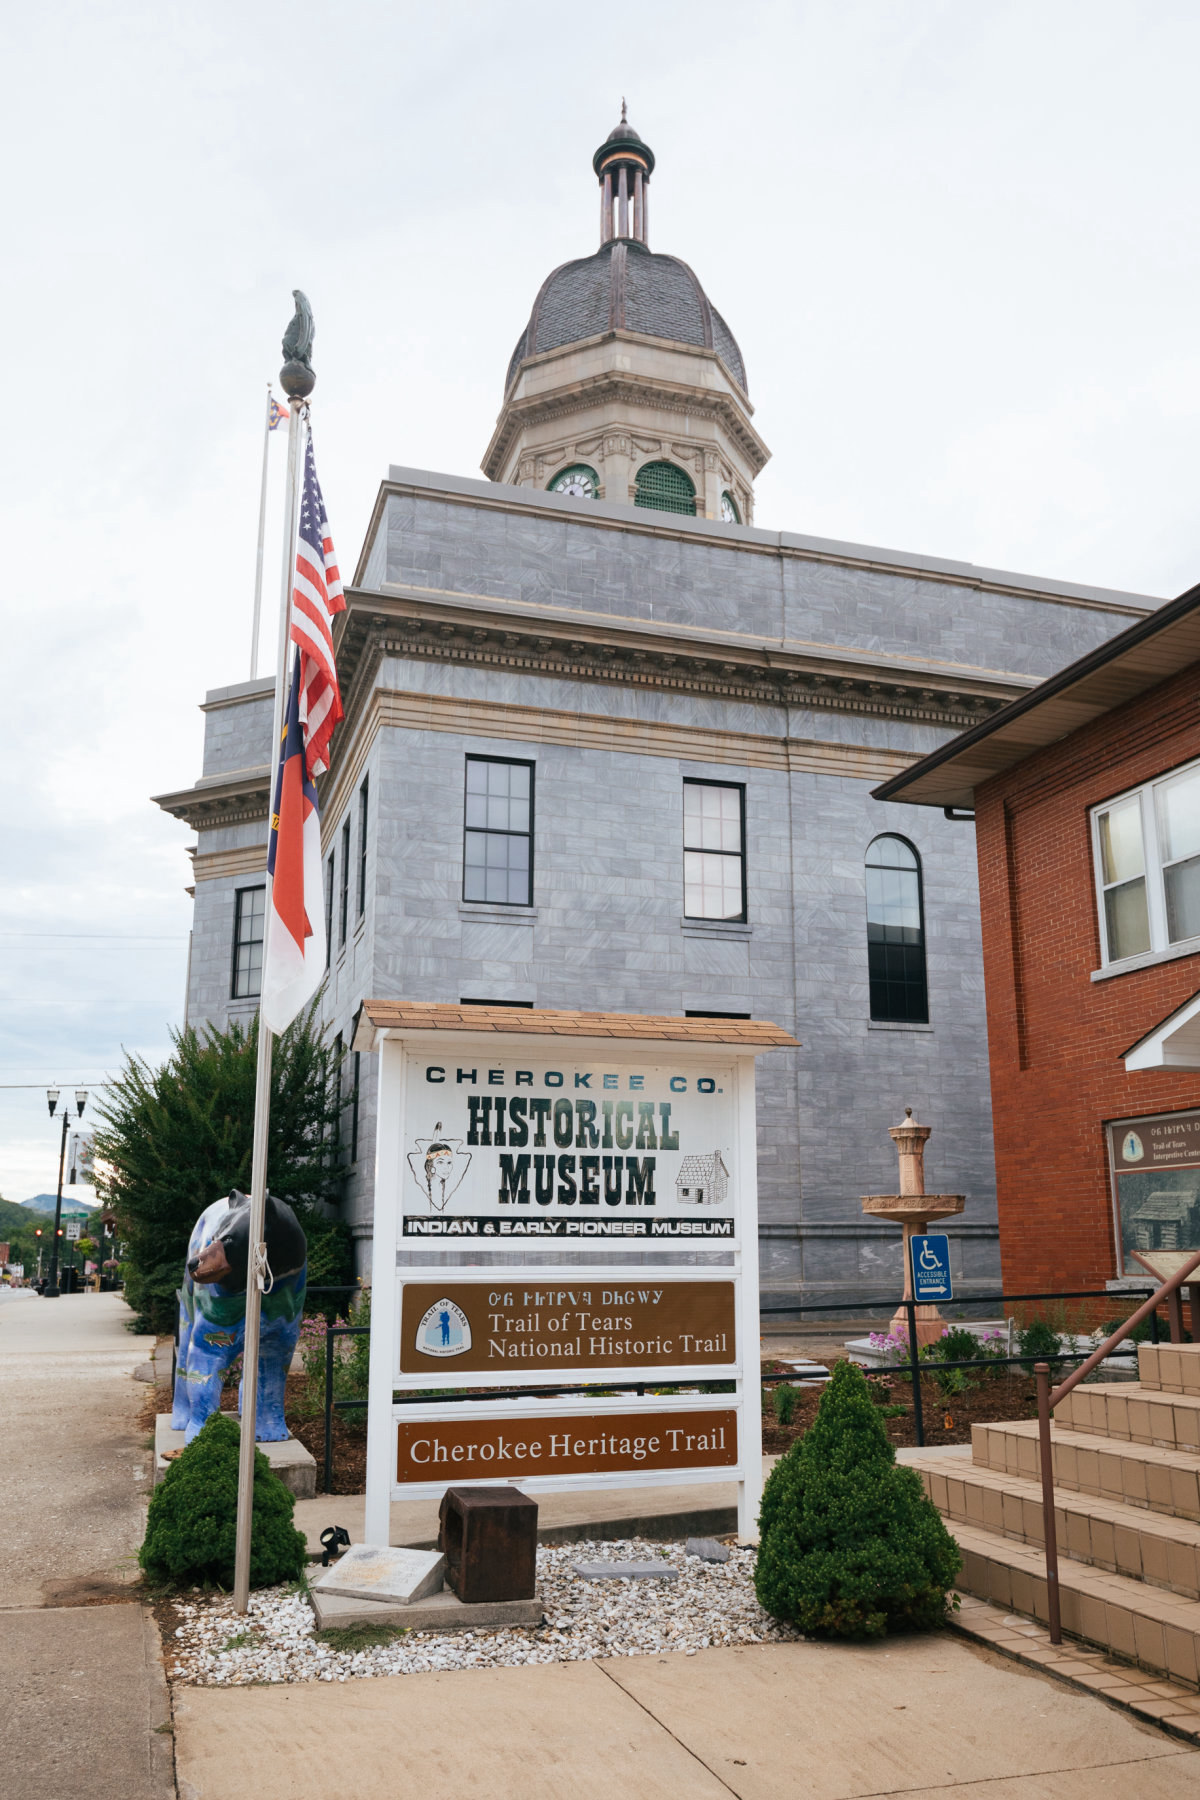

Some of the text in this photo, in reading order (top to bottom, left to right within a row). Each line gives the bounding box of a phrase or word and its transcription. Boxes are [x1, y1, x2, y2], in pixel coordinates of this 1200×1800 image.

[425, 1066, 724, 1094] CHEROKEE CO.
[466, 1095, 680, 1151] HISTORICAL
[1153, 1142, 1165, 1150] Trail
[1172, 1140, 1186, 1148] Tears
[498, 1153, 657, 1206] MUSEUM
[407, 1220, 731, 1235] INDIAN & EARLY PIONEER MUSEUM
[421, 1307, 438, 1327] TRAIL
[451, 1305, 468, 1327] TEARS
[488, 1312, 633, 1333] Trail of Tears
[487, 1334, 727, 1358] National Historic Trail
[409, 1427, 726, 1464] Cherokee Heritage Trail
